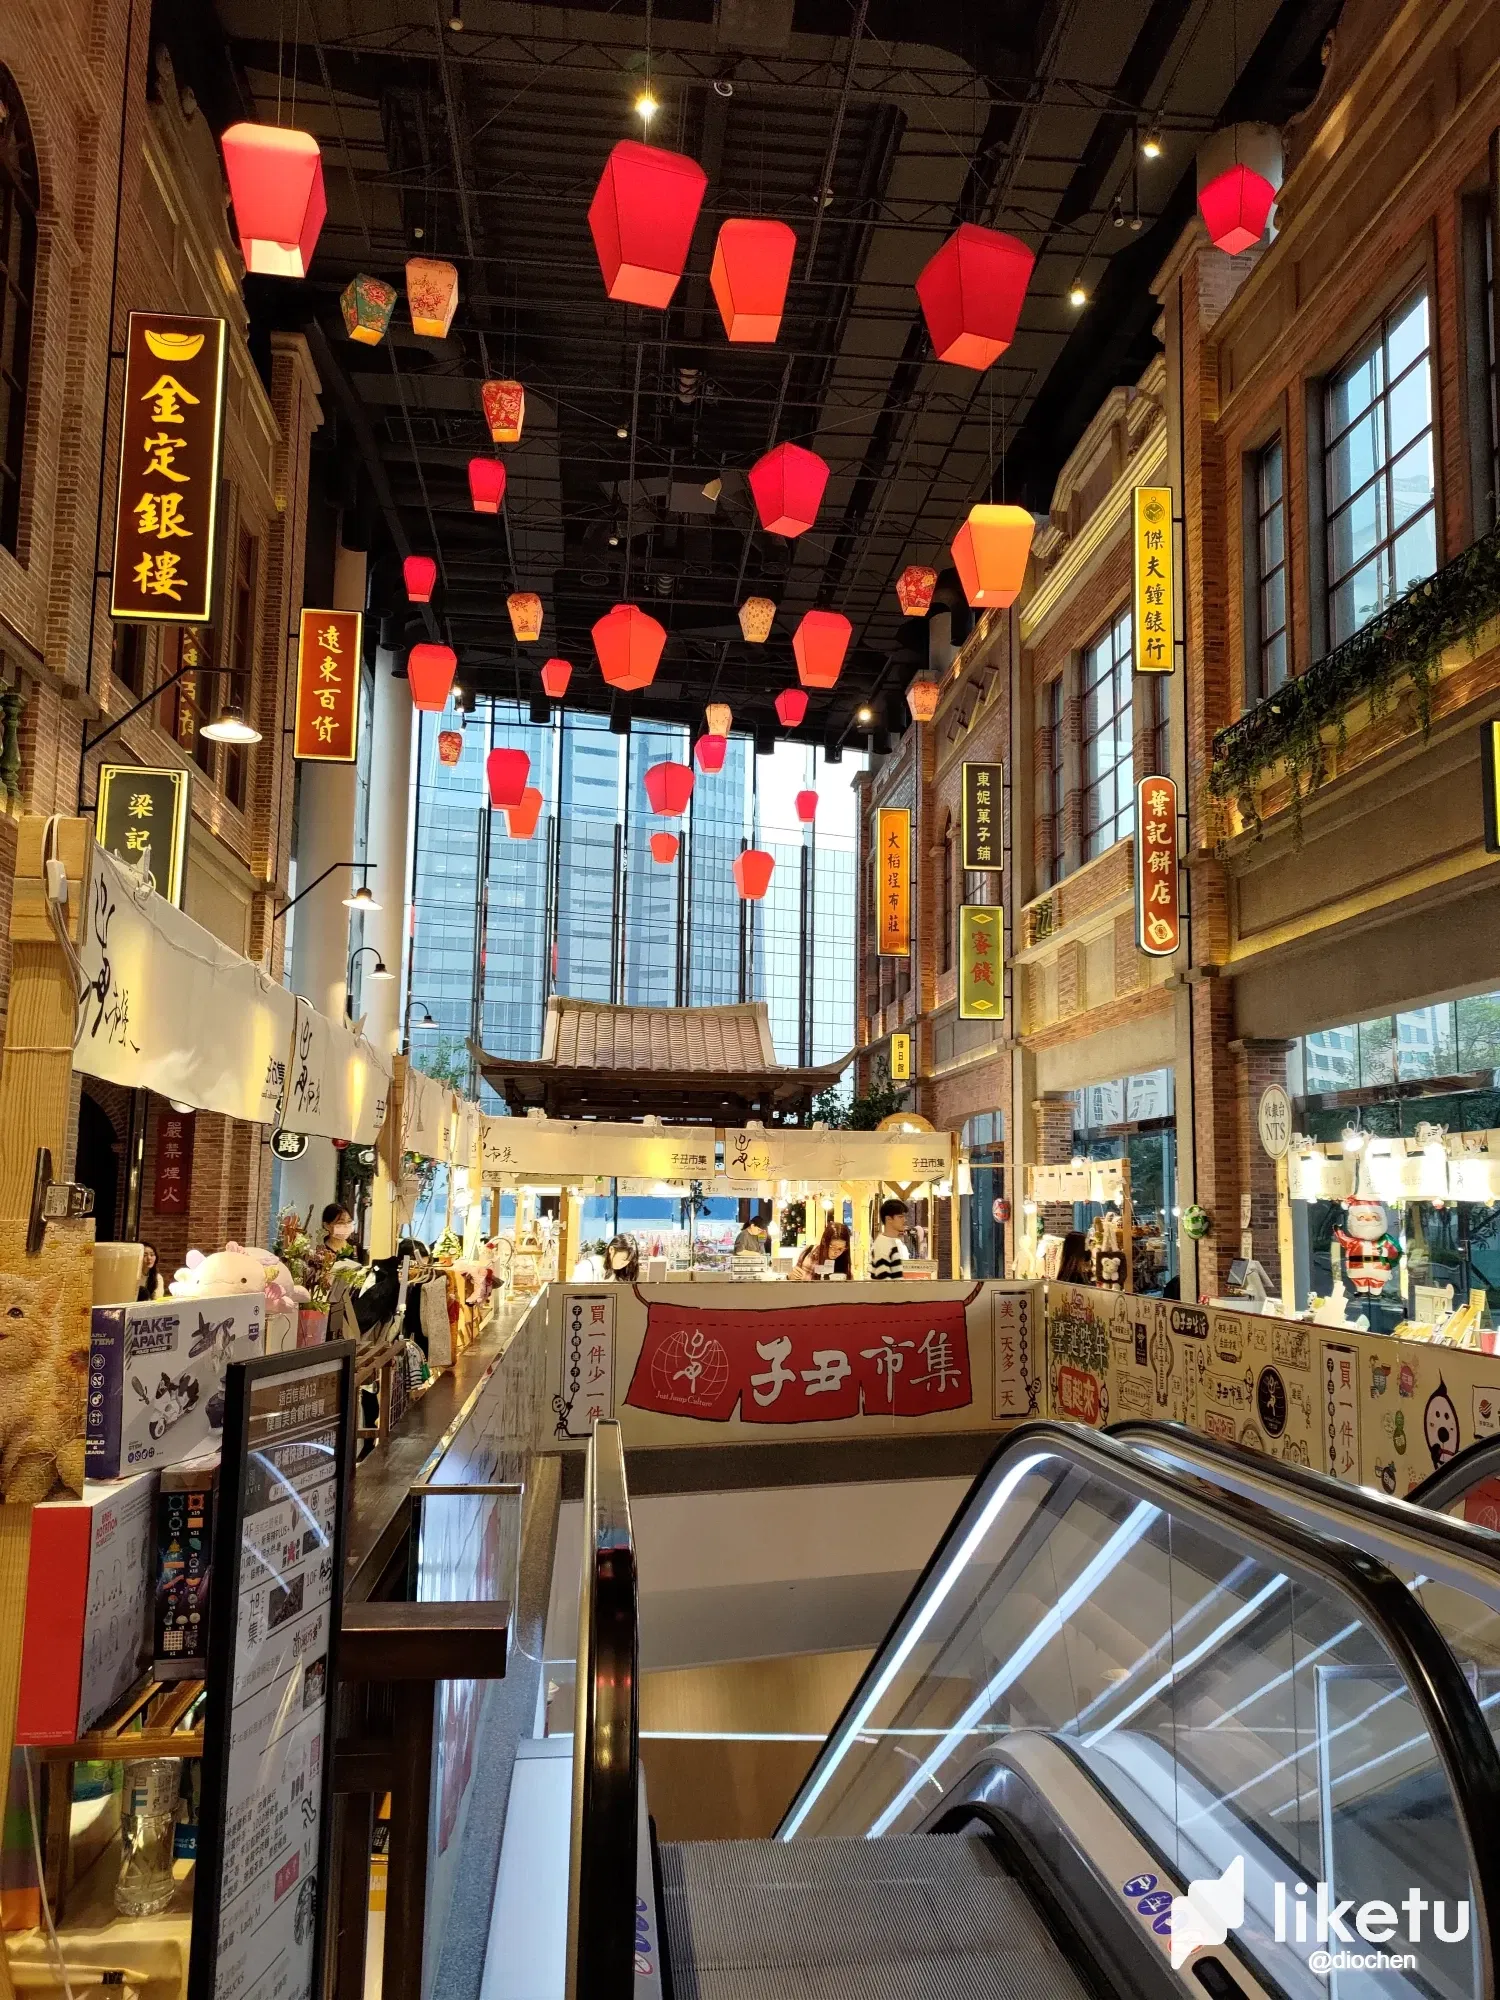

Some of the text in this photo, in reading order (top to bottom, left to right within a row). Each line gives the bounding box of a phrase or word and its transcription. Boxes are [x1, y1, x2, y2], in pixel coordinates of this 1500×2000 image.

[132, 374, 200, 601] 金定銀樓
[1143, 529, 1166, 660] 傑夫鐘錶行
[311, 625, 343, 743] 遠東百貨
[125, 793, 154, 851] 梁記
[1145, 789, 1172, 904] 葉記餅店
[888, 831, 900, 932] 大稻埕布莊
[970, 931, 995, 986] 蜜餞
[161, 1121, 183, 1202] 嚴禁煙火
[671, 1153, 707, 1164] 子丑市集
[912, 1157, 945, 1168] 子丑市集
[131, 1316, 173, 1335] TAKE
[131, 1332, 173, 1348] APART
[586, 1304, 606, 1425] 買一件少一件
[1000, 1300, 1016, 1407] 美一天多一天
[751, 1329, 962, 1407] 子丑市集
